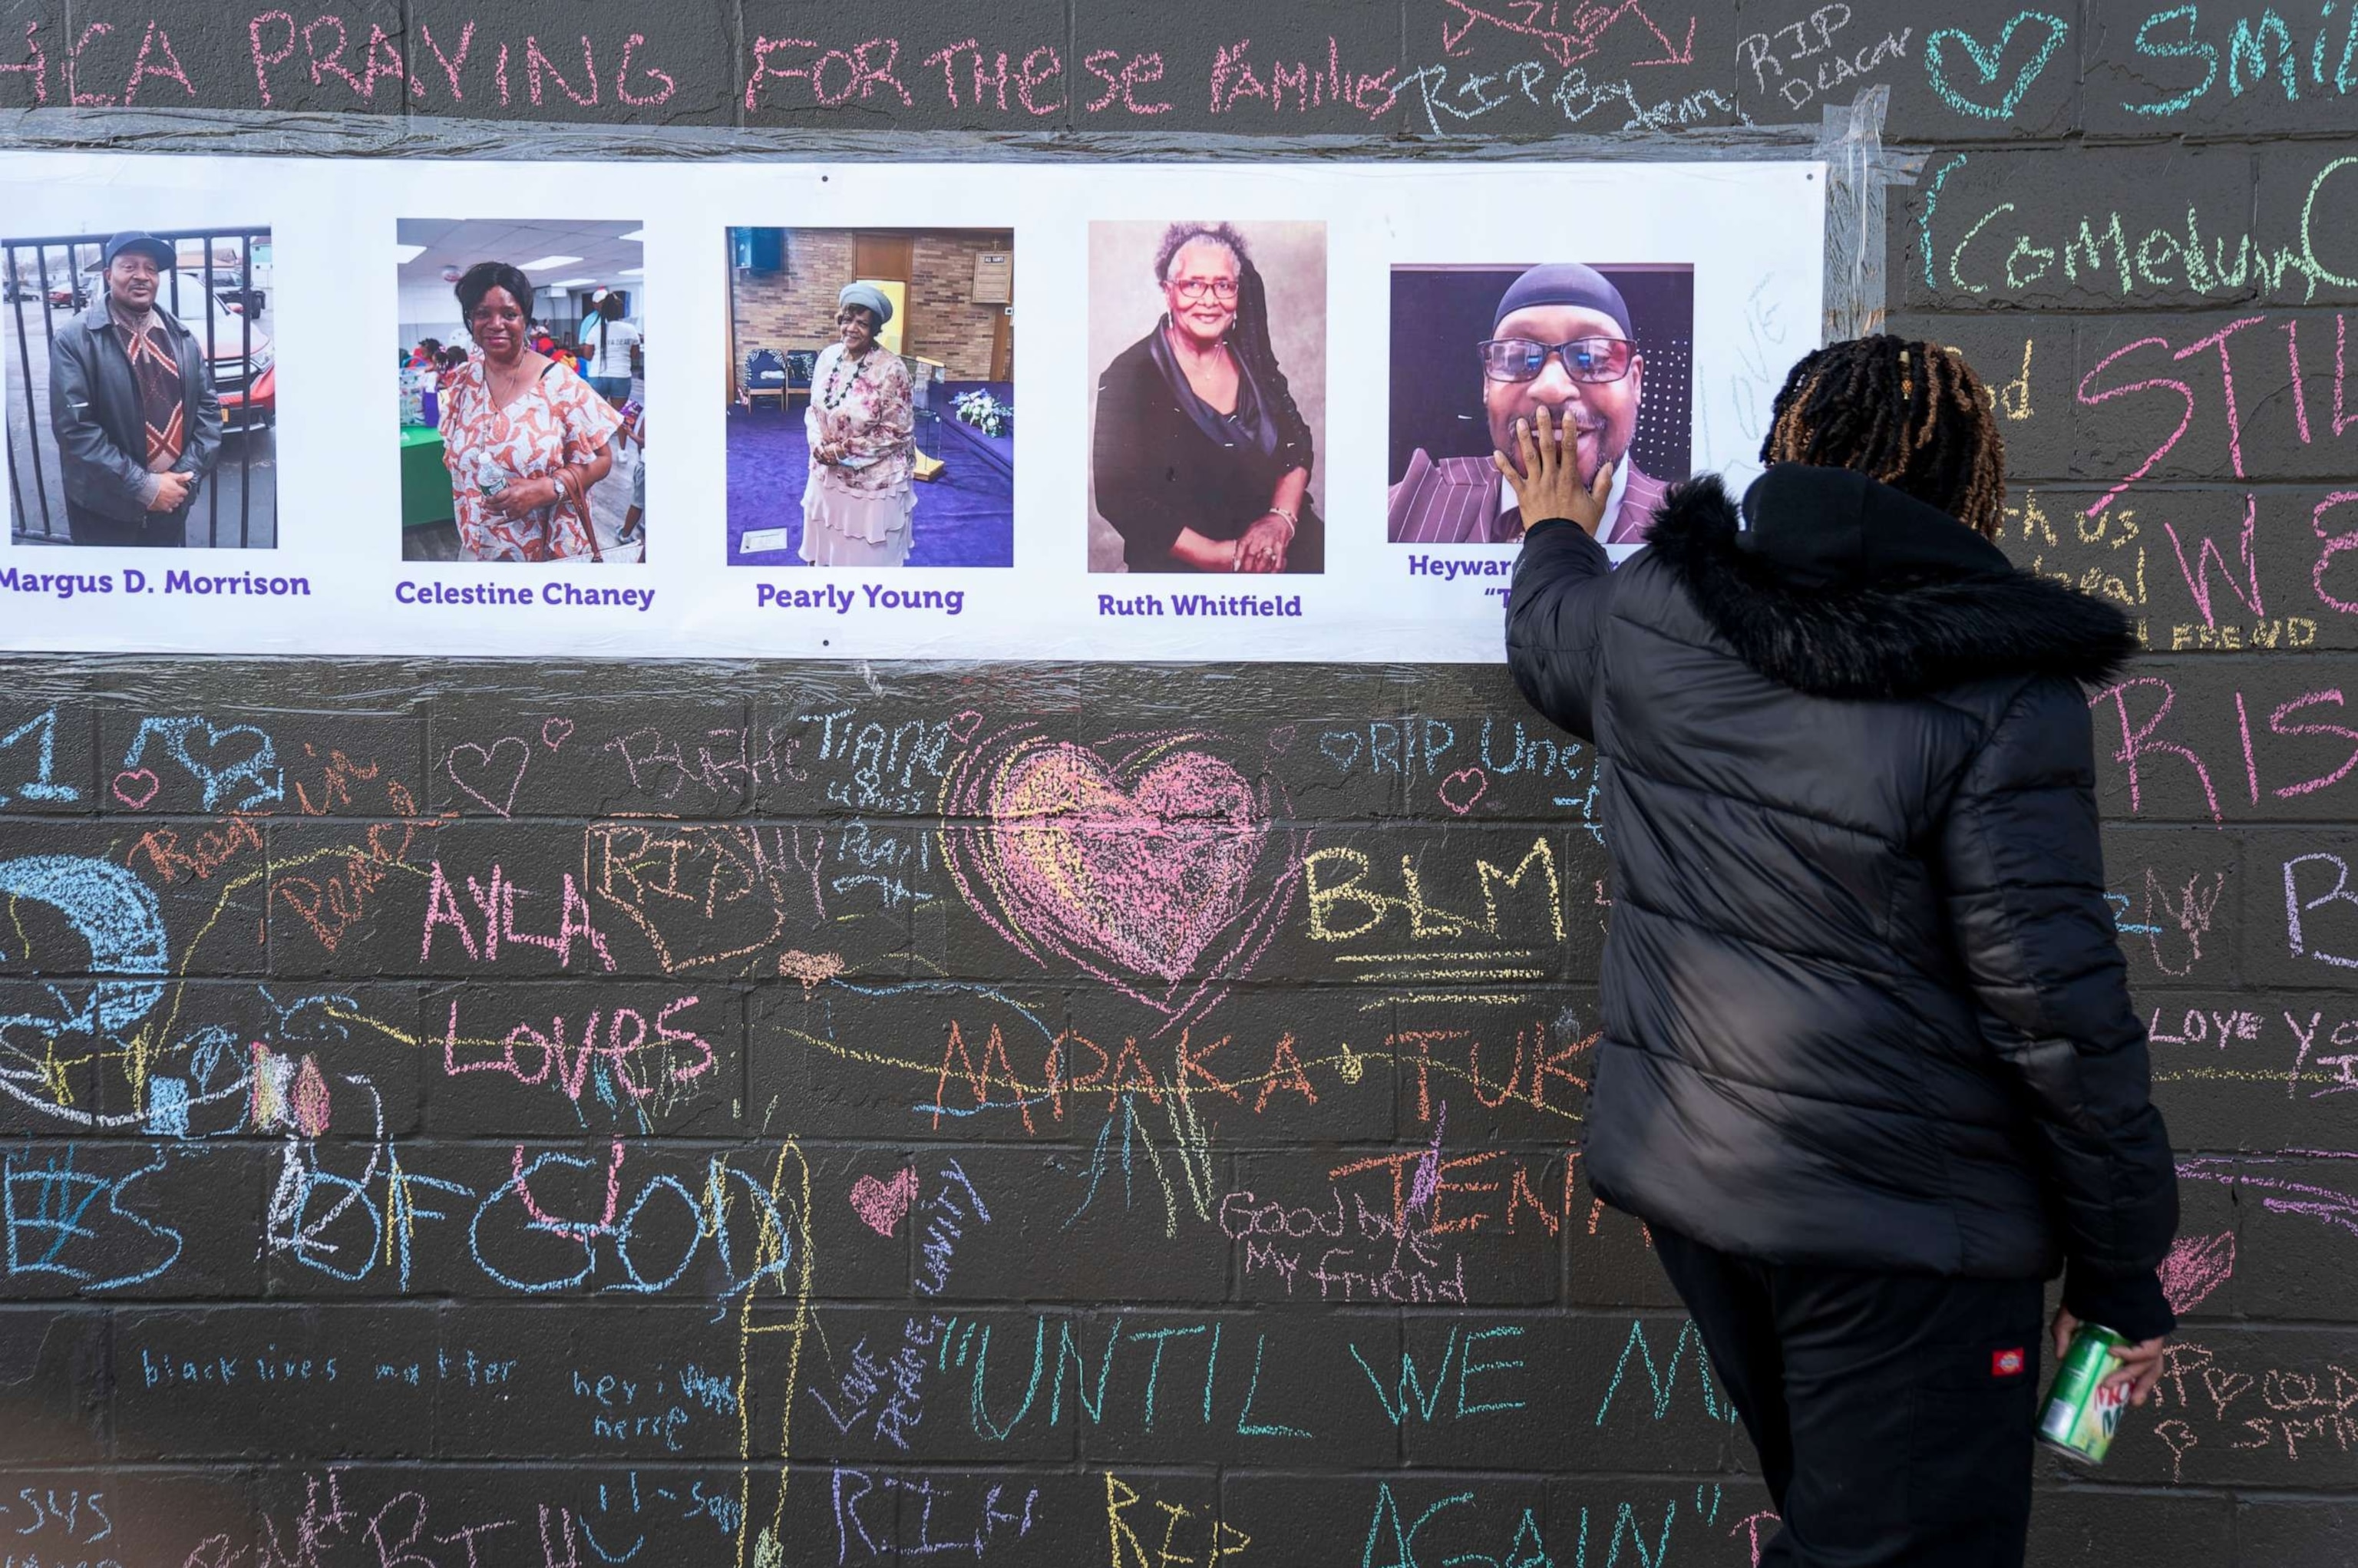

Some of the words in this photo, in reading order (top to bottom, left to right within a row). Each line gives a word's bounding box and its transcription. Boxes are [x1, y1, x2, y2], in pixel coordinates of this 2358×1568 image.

[249, 9, 675, 107] PRAYING
[745, 35, 913, 111] FOR
[0, 567, 113, 599] Margus
[124, 569, 154, 593] D.
[164, 570, 311, 596] Morrison
[1409, 555, 1511, 582] Heywar
[395, 581, 533, 605] Celestine
[542, 583, 655, 612] Chaney
[756, 583, 854, 615] Pearly
[863, 584, 963, 616] Young
[1098, 594, 1164, 616] Ruth
[1171, 595, 1302, 616] Whitfield
[1369, 718, 1455, 777] RIP
[1305, 835, 1568, 946] BLM
[419, 859, 617, 973] AYLA
[1349, 1325, 1527, 1428] WE
